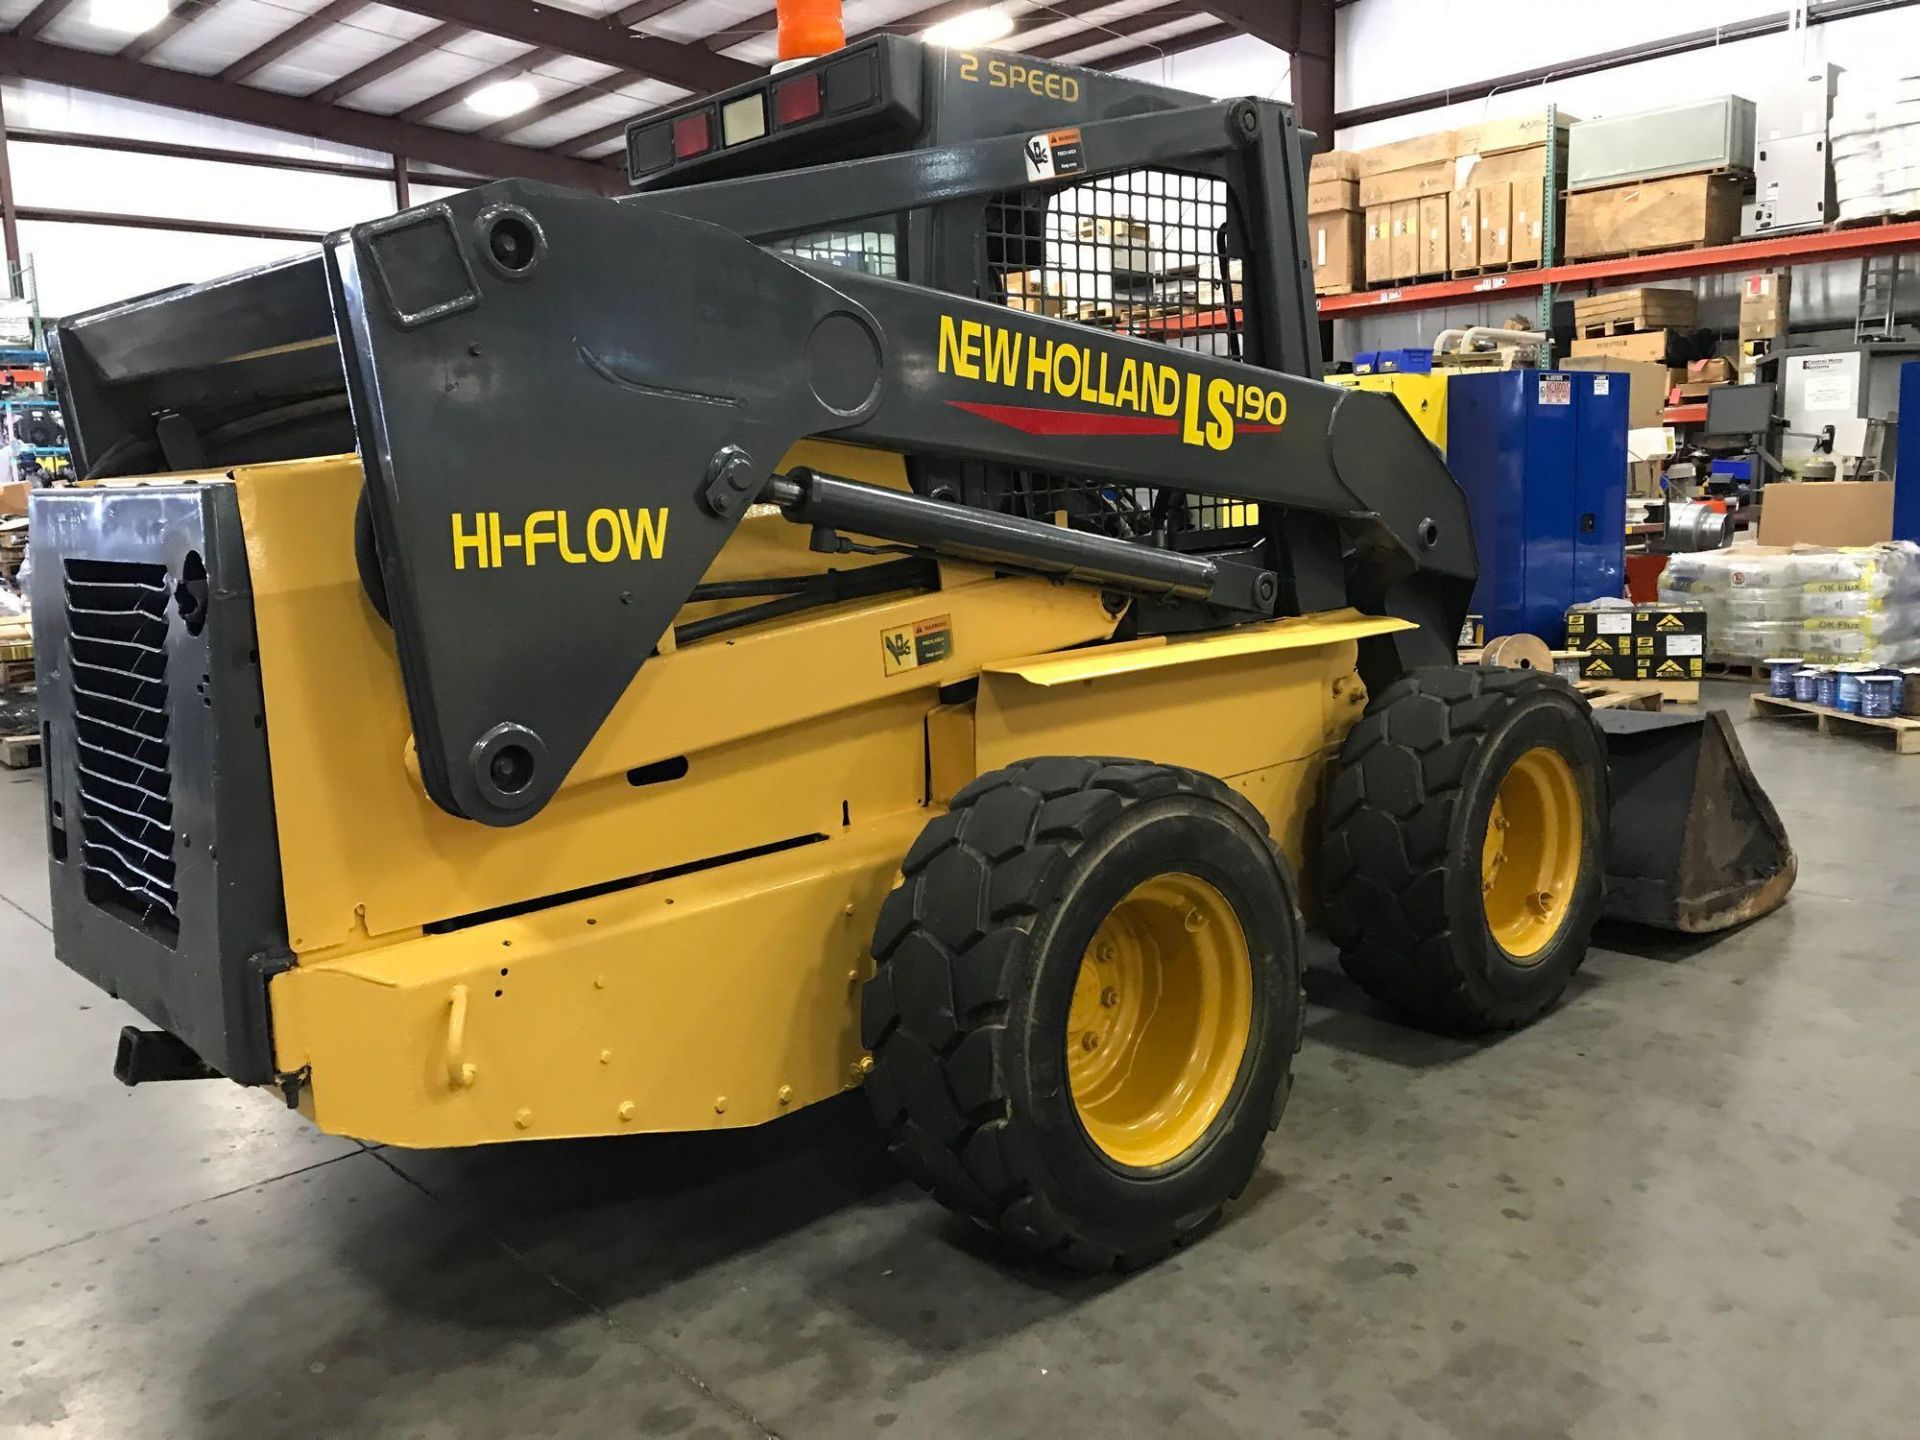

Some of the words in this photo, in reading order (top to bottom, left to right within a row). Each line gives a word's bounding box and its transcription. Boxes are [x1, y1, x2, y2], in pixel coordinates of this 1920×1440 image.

[960, 53, 979, 82] 2
[988, 60, 1079, 103] SPEED
[938, 315, 1022, 387] NEW
[1027, 336, 1180, 417] HOLLAND
[452, 507, 669, 570] HI-FLOW
